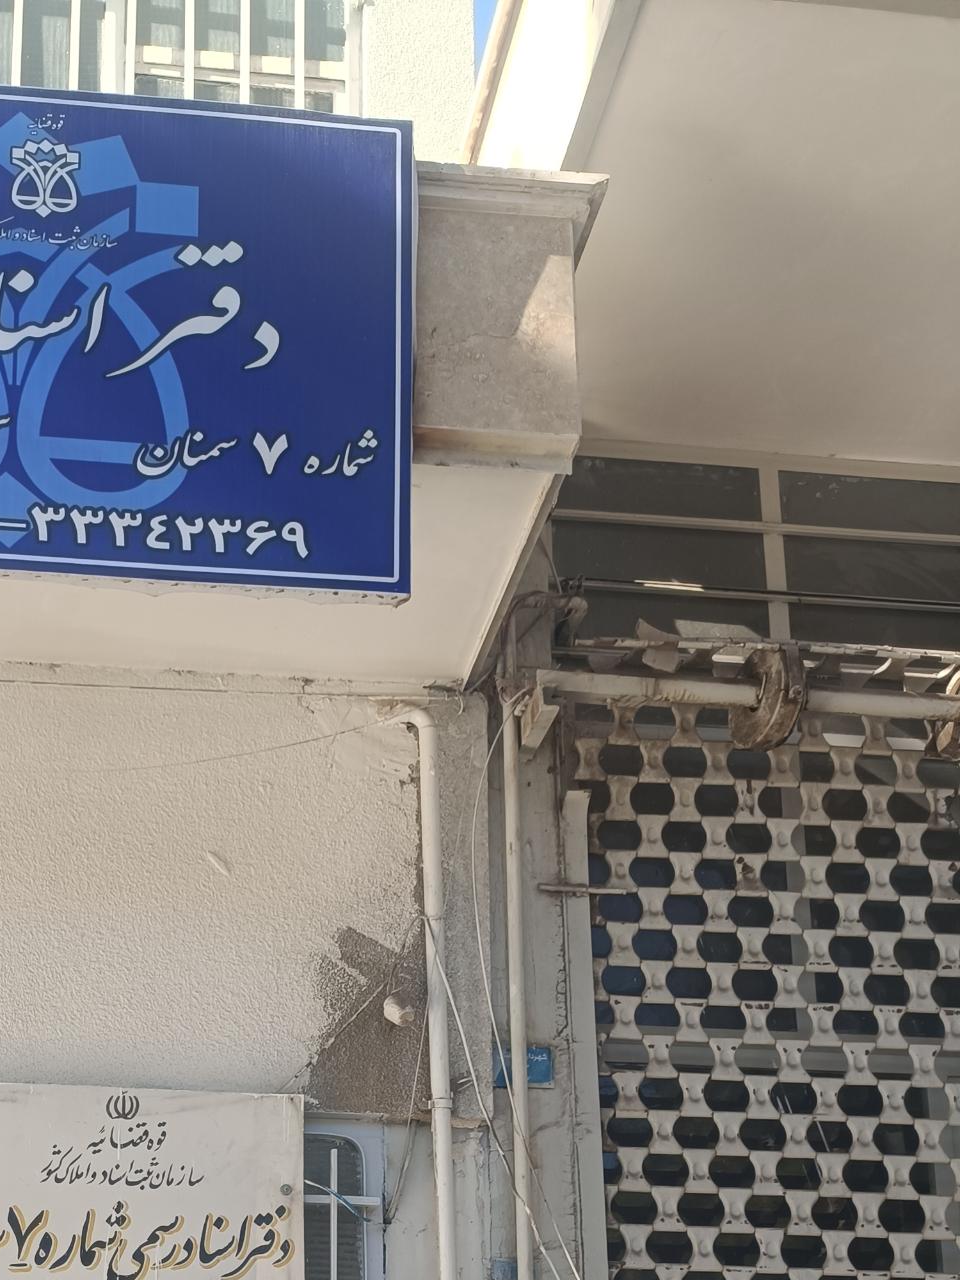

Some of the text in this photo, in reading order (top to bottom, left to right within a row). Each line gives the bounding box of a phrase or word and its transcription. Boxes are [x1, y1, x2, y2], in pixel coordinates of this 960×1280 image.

[52, 114, 65, 130] قوه
[13, 233, 20, 241] و
[22, 229, 46, 242] اسناد
[48, 226, 80, 249] ثبت
[77, 234, 118, 250] سازمان
[106, 240, 280, 377] دفتر
[136, 429, 378, 476] شماره ۷ سمنان
[146, 1121, 167, 1152] قوه
[40, 1144, 205, 1190] سازمان ثبت اسناد و املاک کشور
[7, 1204, 49, 1273] ۷
[34, 1200, 132, 1273] شماره
[172, 1212, 253, 1271] اسناد
